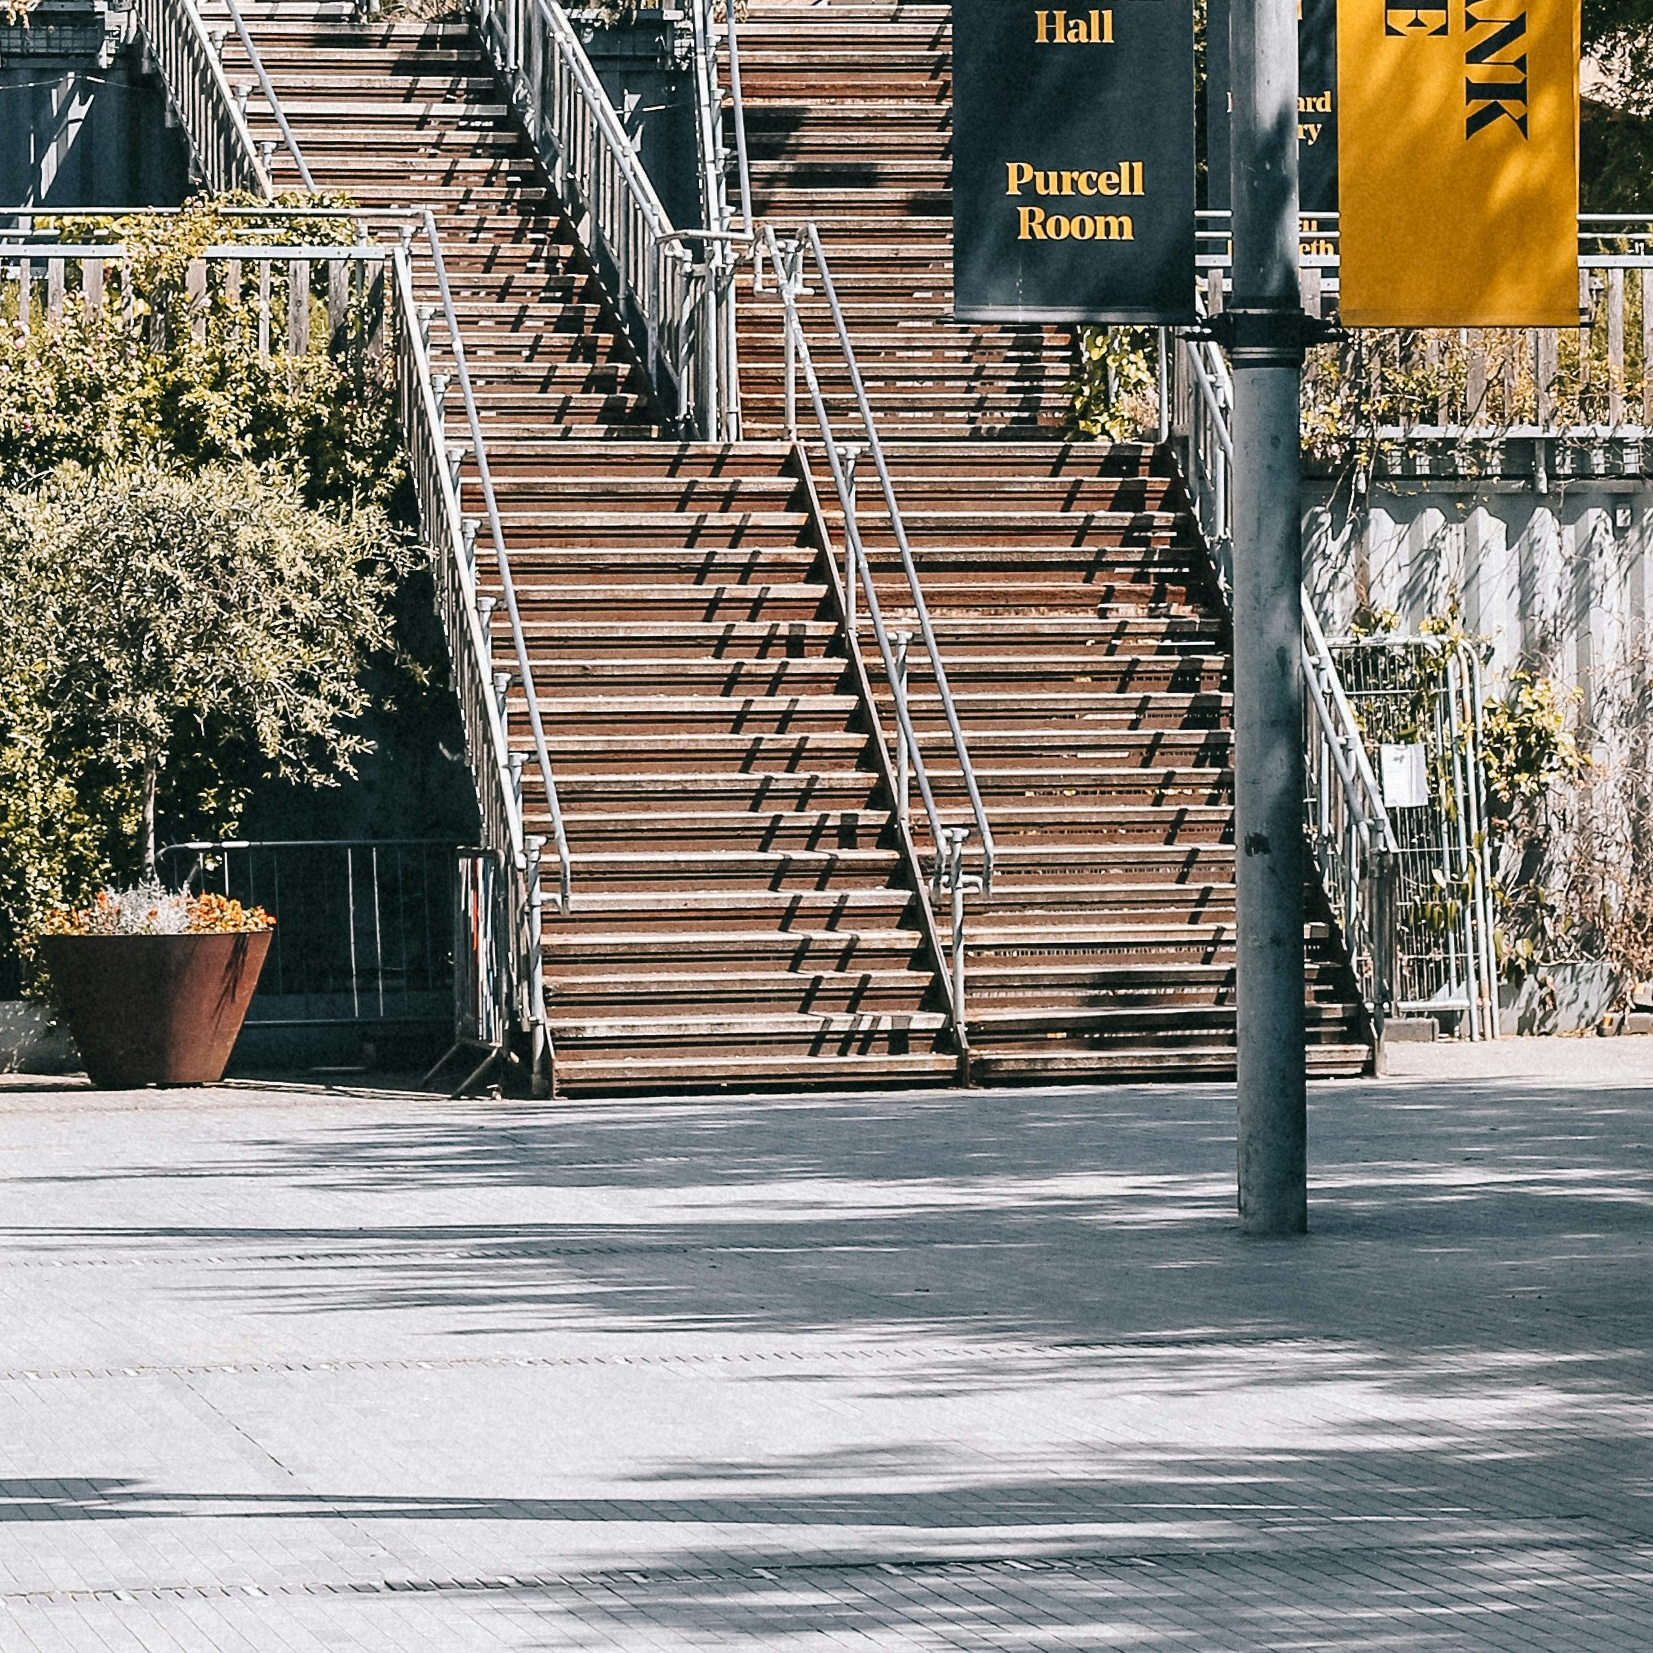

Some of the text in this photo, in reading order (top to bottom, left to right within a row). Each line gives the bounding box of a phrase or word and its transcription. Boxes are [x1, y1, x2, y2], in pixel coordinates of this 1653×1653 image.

[1036, 8, 1114, 44] Hall
[1006, 161, 1144, 196] Purcell
[1017, 206, 1134, 241] Room
